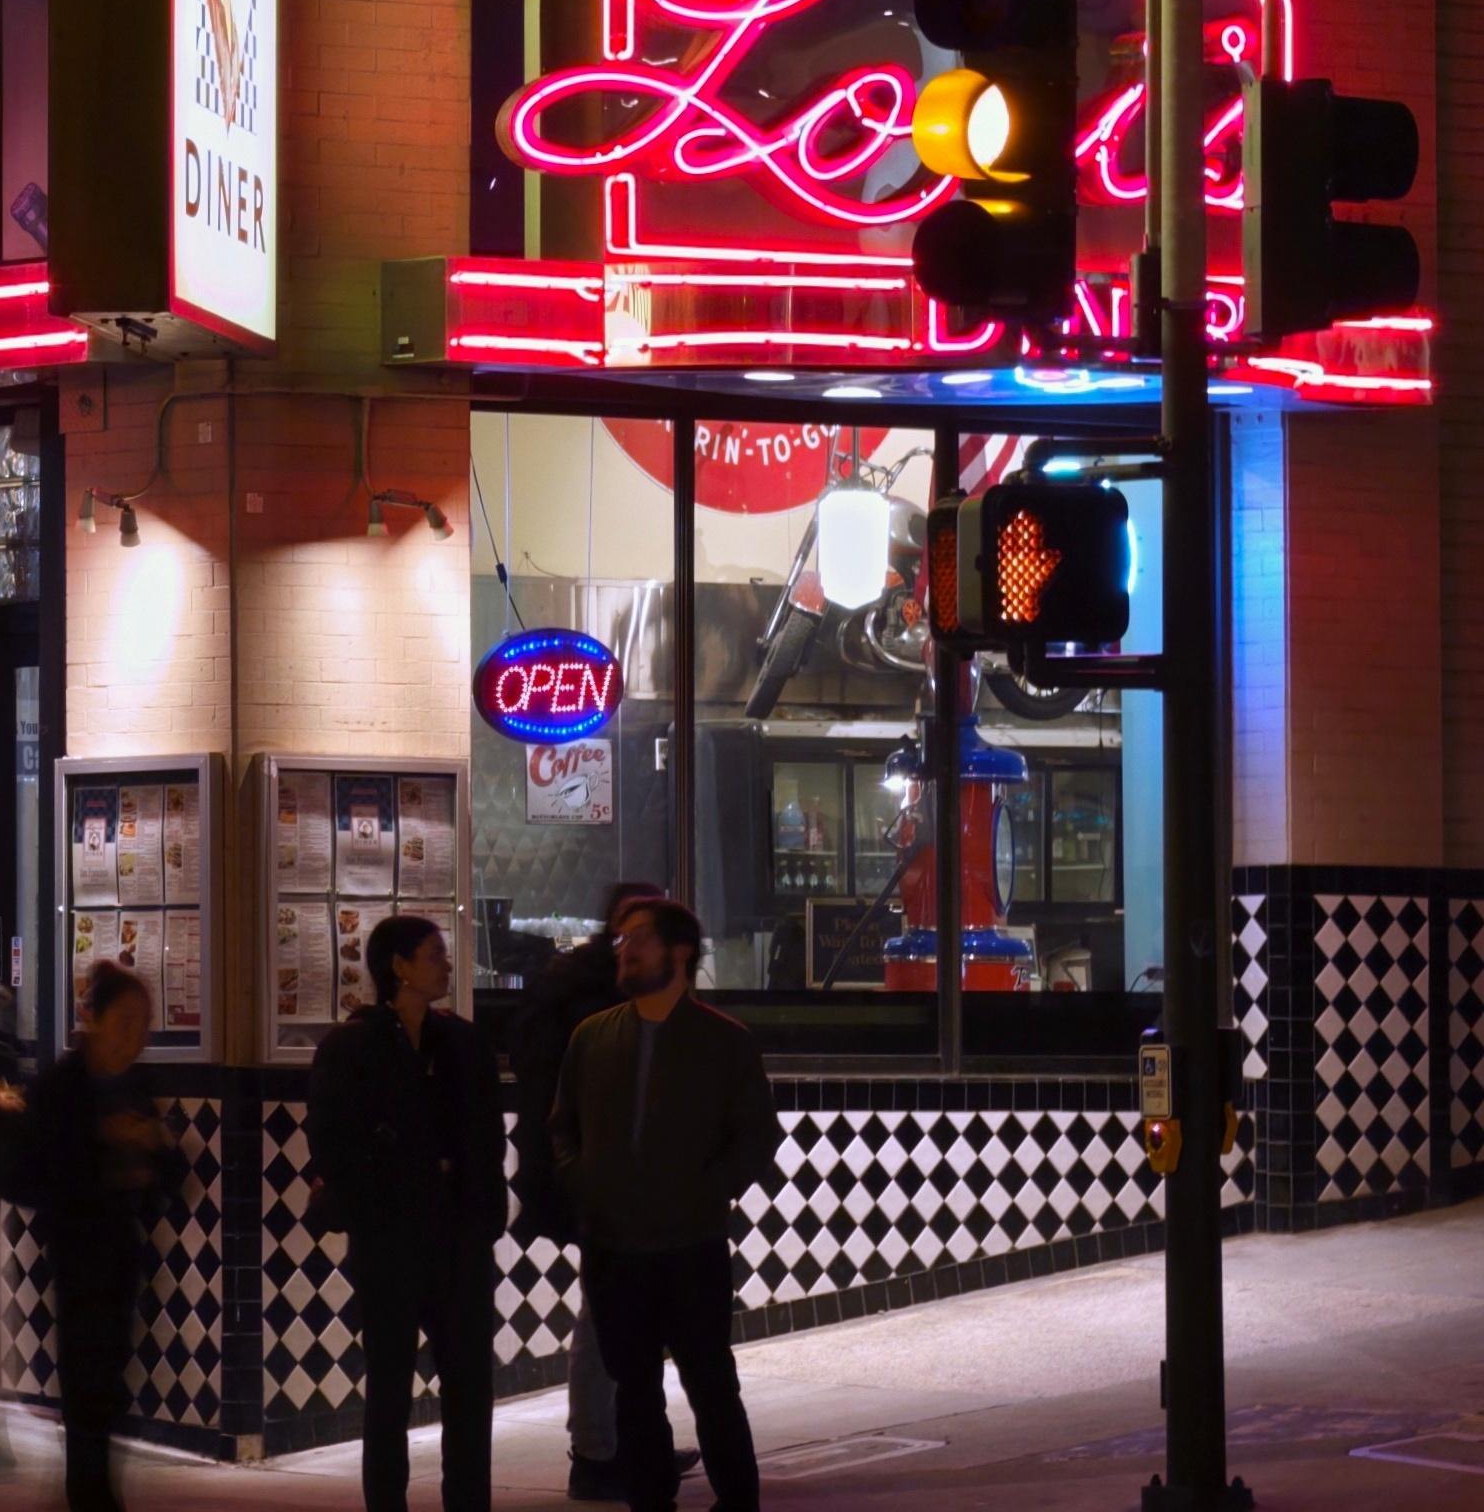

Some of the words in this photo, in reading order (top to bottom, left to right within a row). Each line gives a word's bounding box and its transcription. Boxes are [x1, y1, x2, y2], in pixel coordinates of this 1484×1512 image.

[185, 137, 266, 254] DINER
[496, 664, 614, 713] OPEN
[529, 743, 606, 788] Coffee
